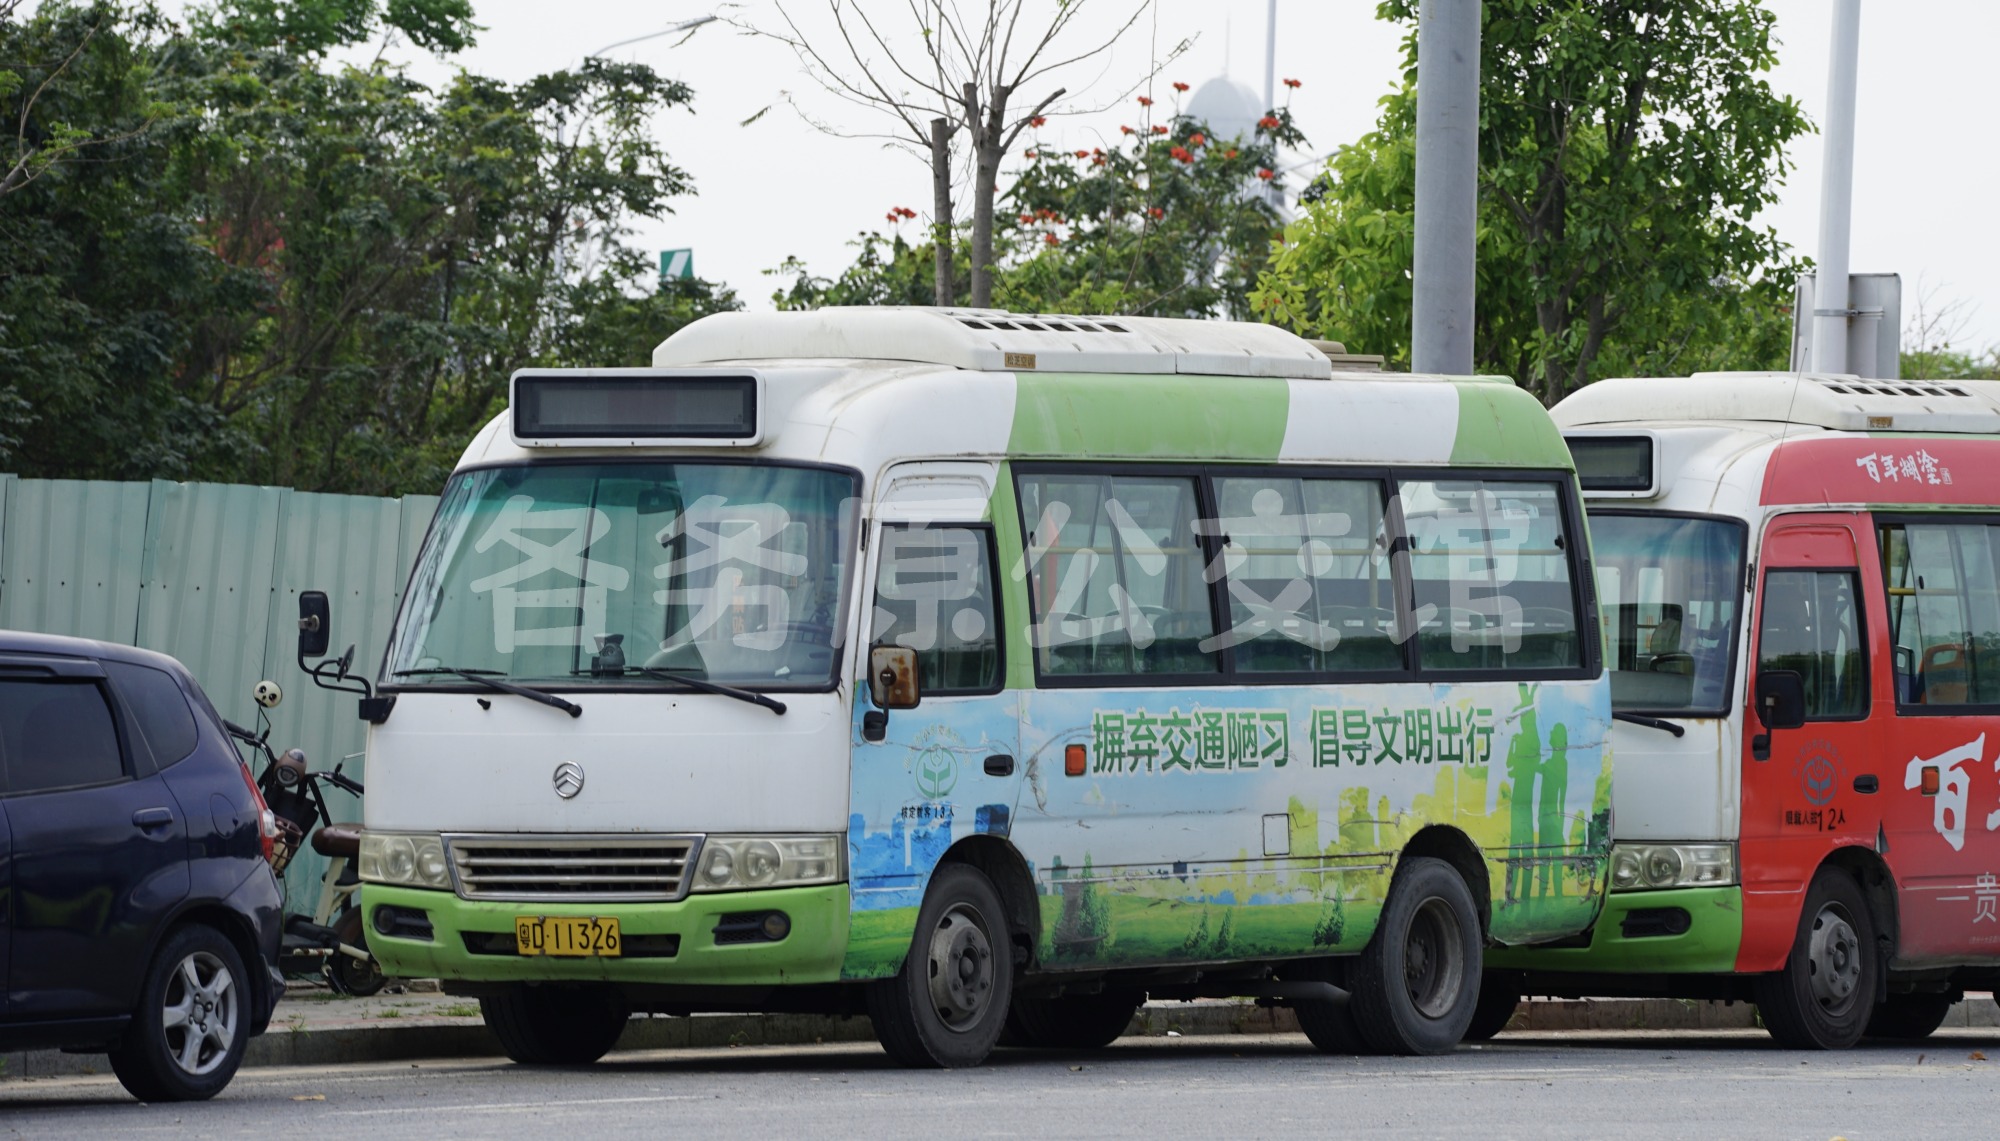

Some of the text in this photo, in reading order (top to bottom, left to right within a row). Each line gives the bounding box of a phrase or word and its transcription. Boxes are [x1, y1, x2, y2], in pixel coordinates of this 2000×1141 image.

[1093, 705, 1495, 773] 摒弃交通陋习 倡导文明出行
